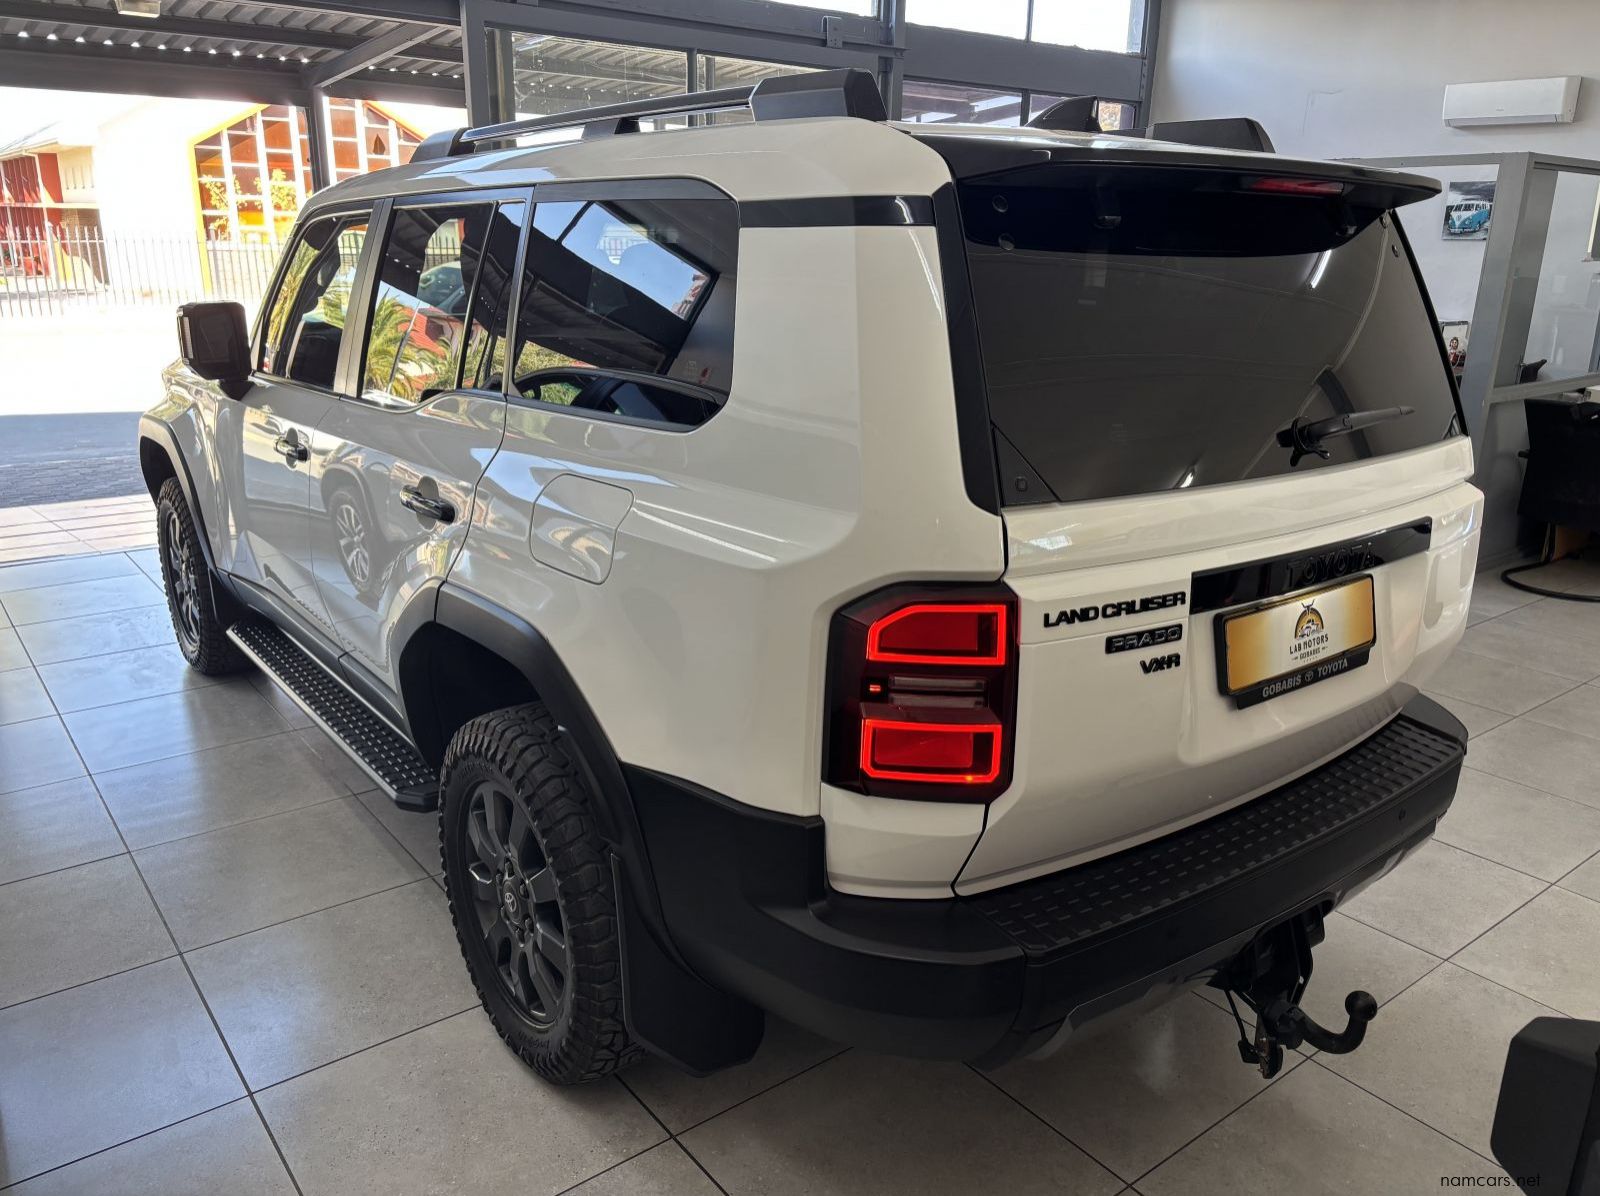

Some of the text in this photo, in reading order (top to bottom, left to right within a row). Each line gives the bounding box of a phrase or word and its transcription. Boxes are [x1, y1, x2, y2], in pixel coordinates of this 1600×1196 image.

[1286, 541, 1376, 588] TOYOTA
[1043, 591, 1186, 628] LAND CRUISER
[1111, 626, 1181, 652] PRADO
[1289, 633, 1329, 655] LAB MOTORS
[1262, 658, 1348, 697] GOBABIS TOYOTA
